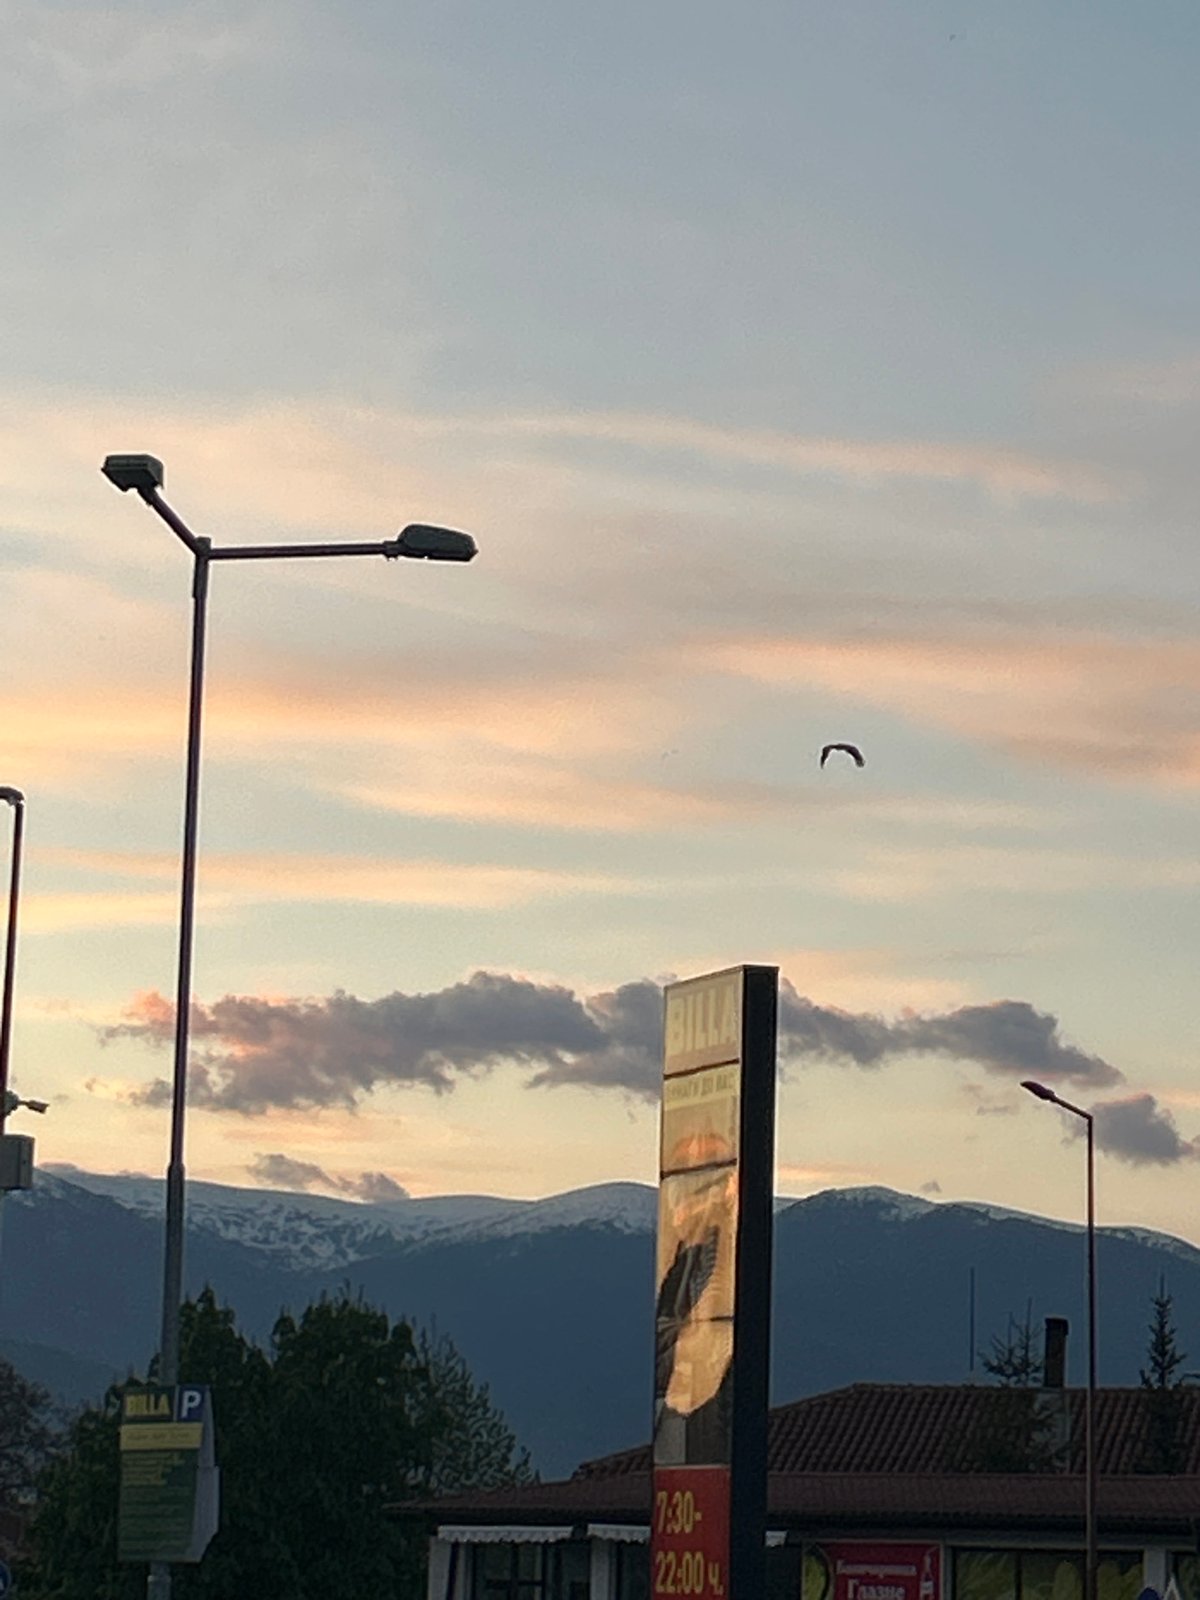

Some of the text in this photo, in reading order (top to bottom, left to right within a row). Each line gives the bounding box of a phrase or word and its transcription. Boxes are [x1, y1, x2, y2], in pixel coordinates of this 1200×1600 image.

[668, 984, 737, 1056] BILLA
[182, 1391, 201, 1418] P
[656, 1491, 702, 1534] 7:30-
[655, 1551, 705, 1595] 22:00
